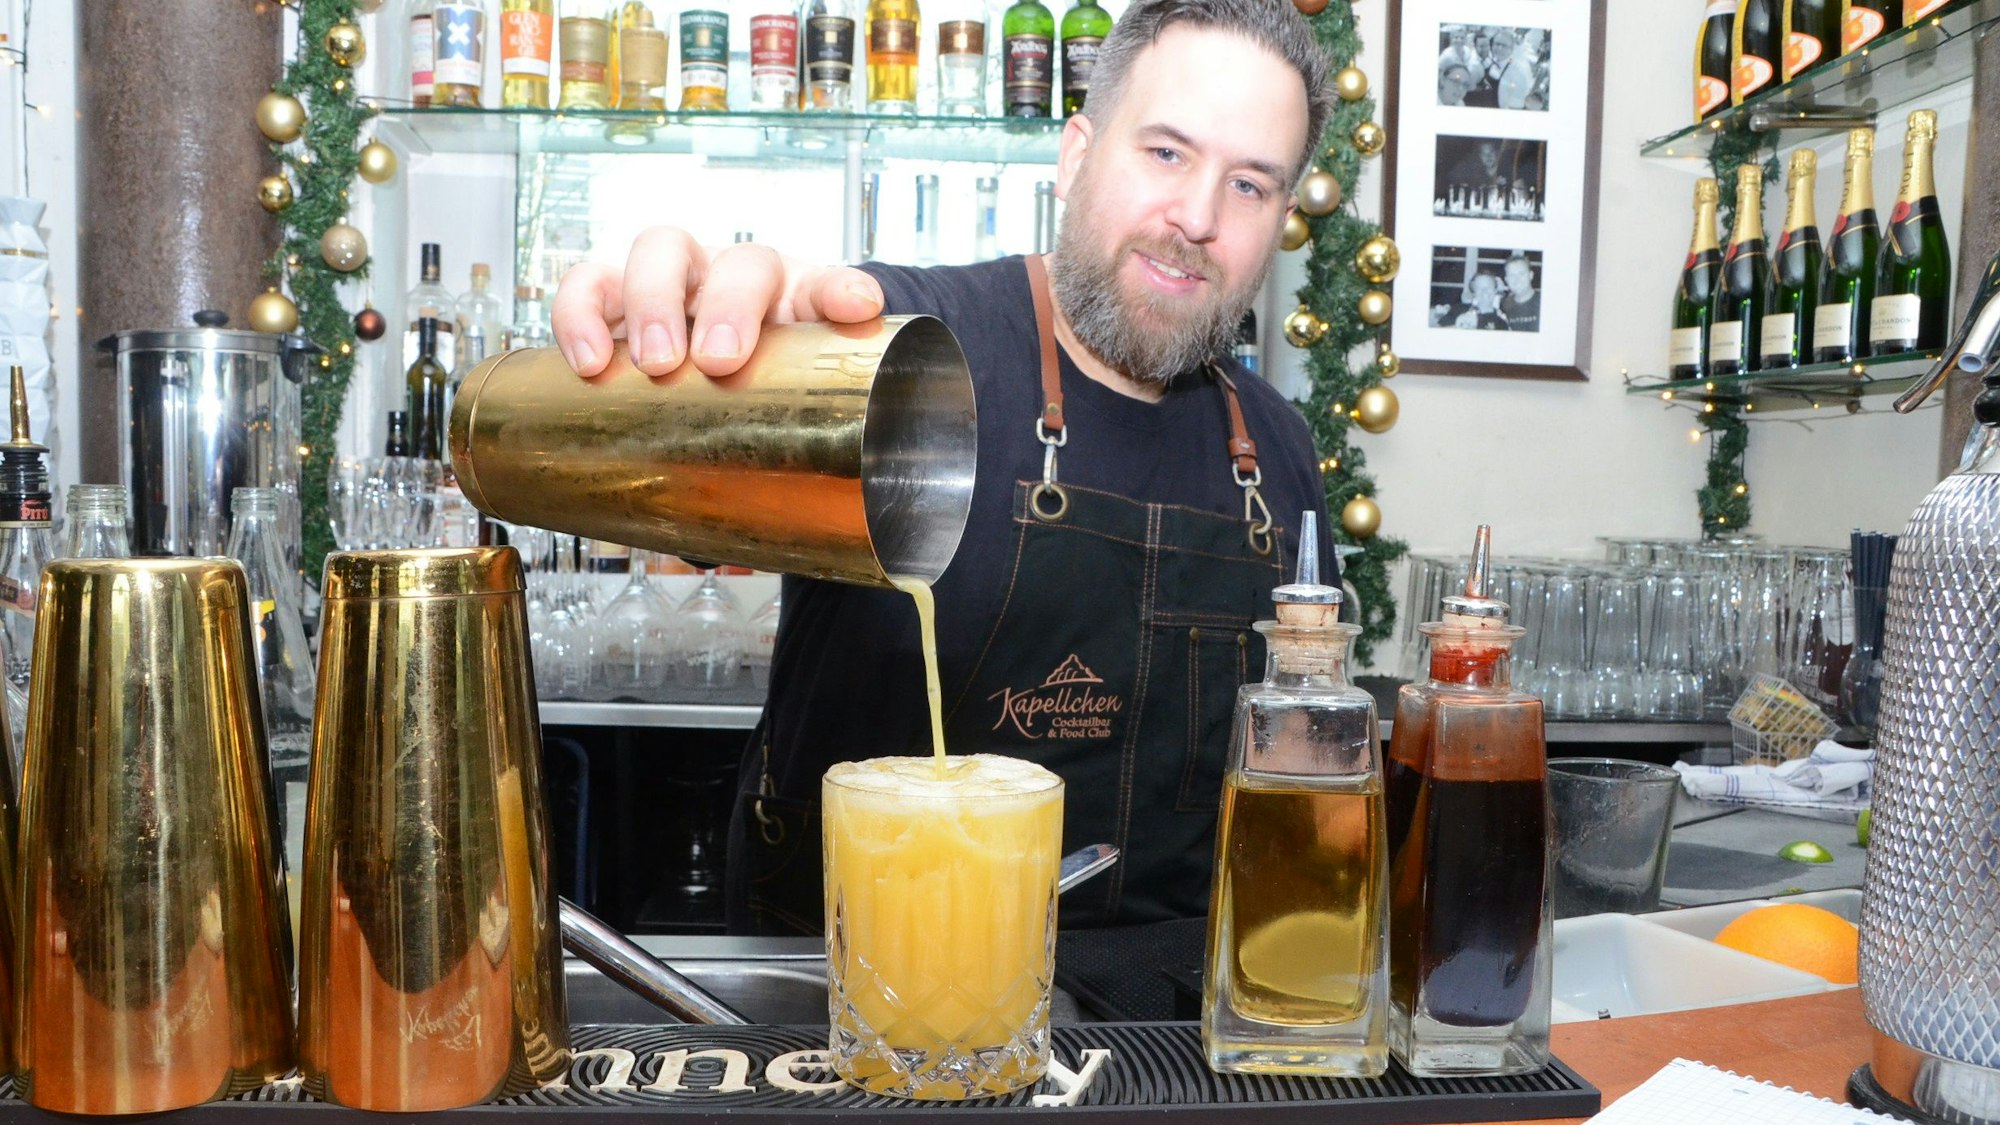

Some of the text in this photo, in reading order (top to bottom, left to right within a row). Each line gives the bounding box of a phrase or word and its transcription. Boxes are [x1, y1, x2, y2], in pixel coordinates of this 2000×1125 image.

[987, 687, 1122, 738] Kapellchen
[1052, 717, 1111, 727] Cocktailbar
[1047, 729, 1111, 738] & Food Club
